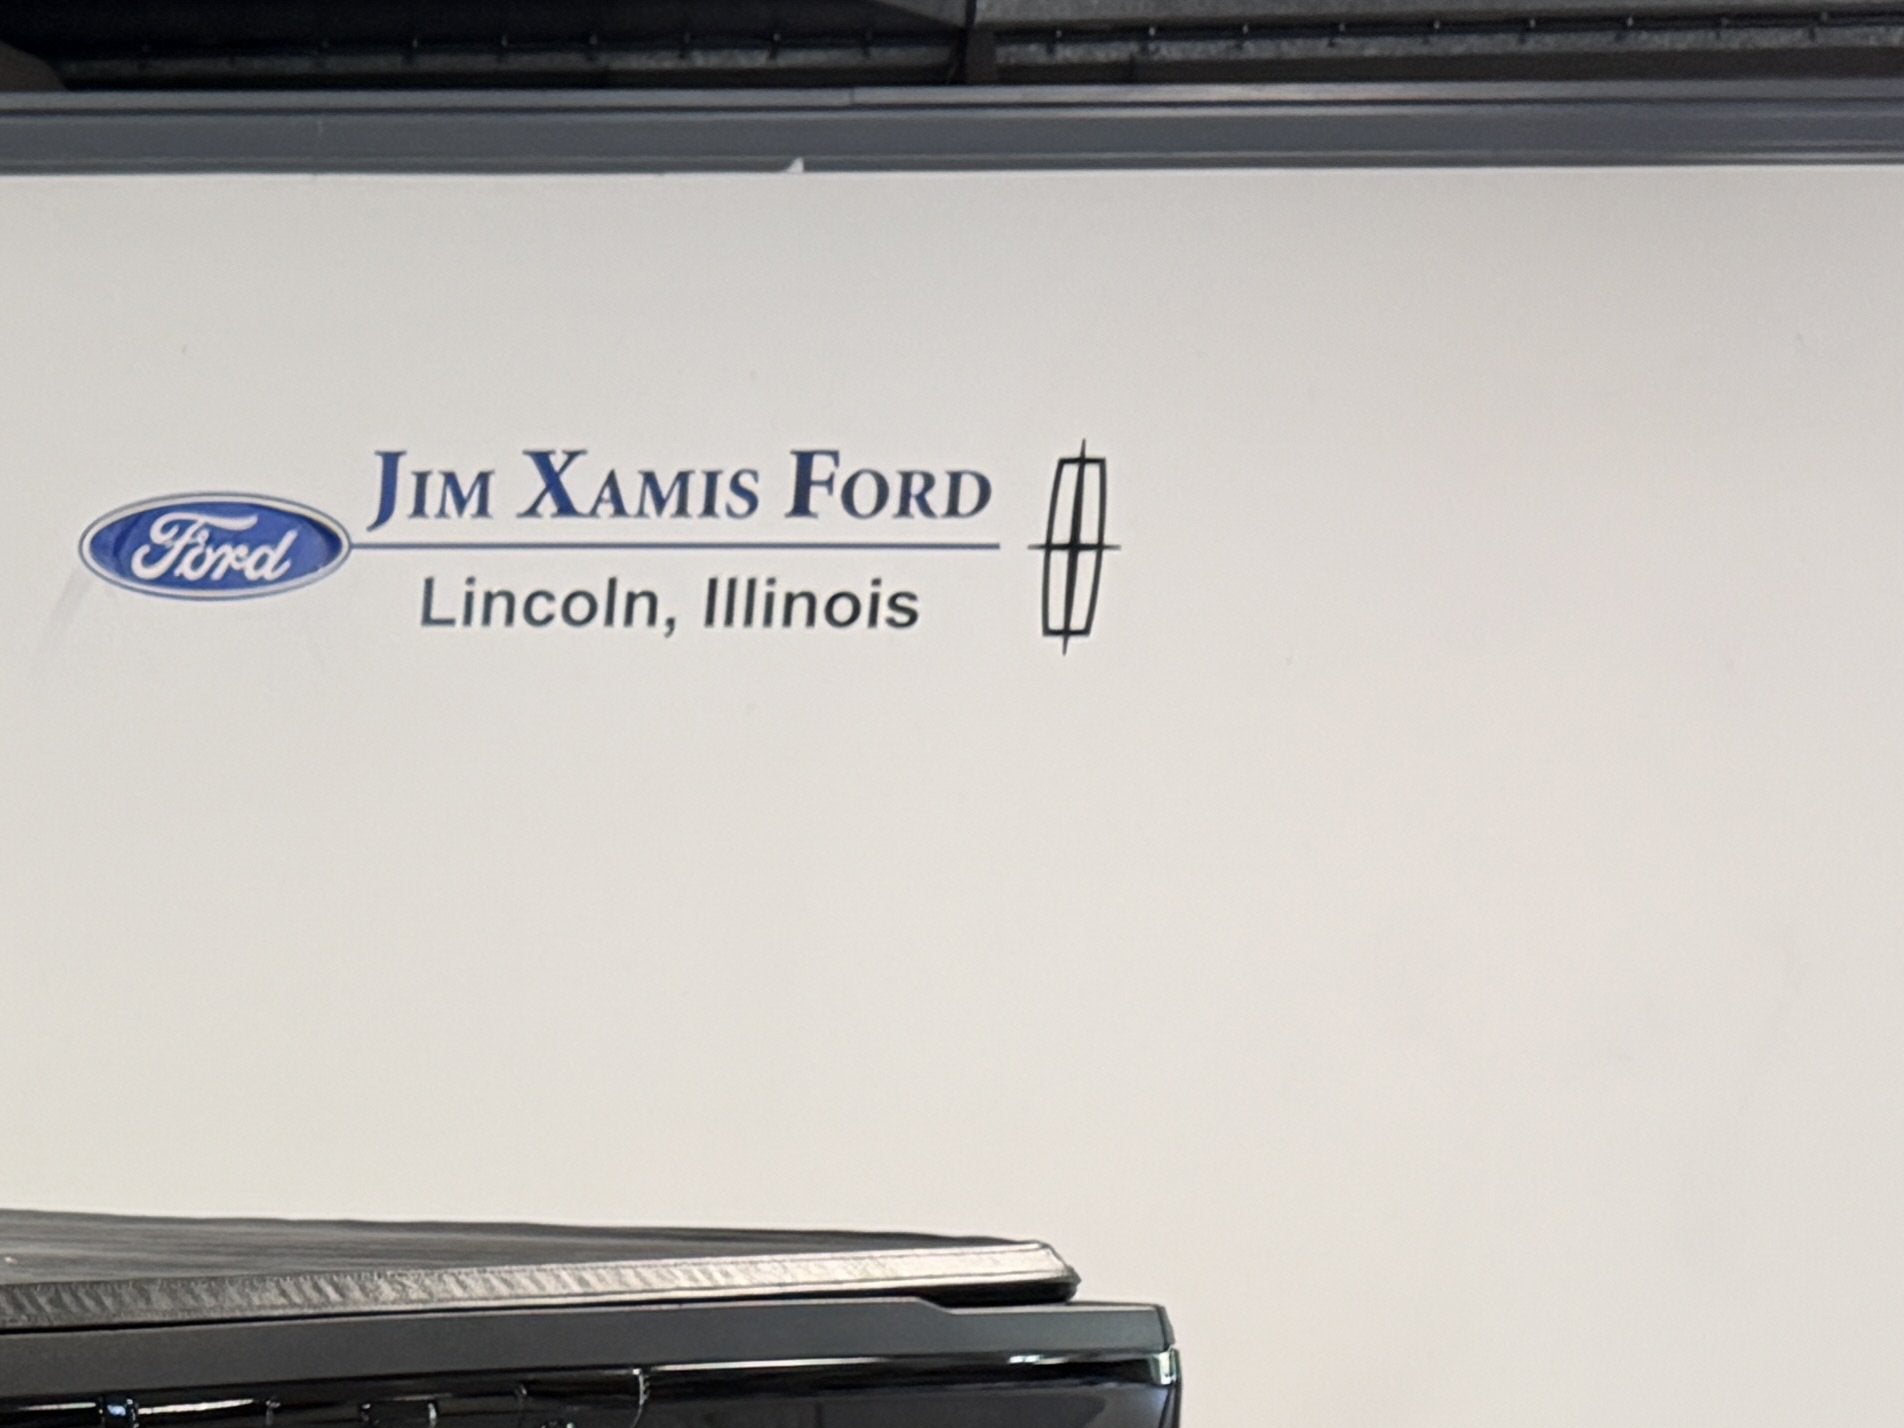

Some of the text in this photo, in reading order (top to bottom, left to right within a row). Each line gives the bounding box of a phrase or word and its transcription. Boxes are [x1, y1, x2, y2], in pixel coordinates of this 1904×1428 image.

[366, 448, 994, 532] JIM XAMIS FORD
[129, 512, 293, 583] Ford
[419, 575, 920, 639] Lincoln, Illinois
